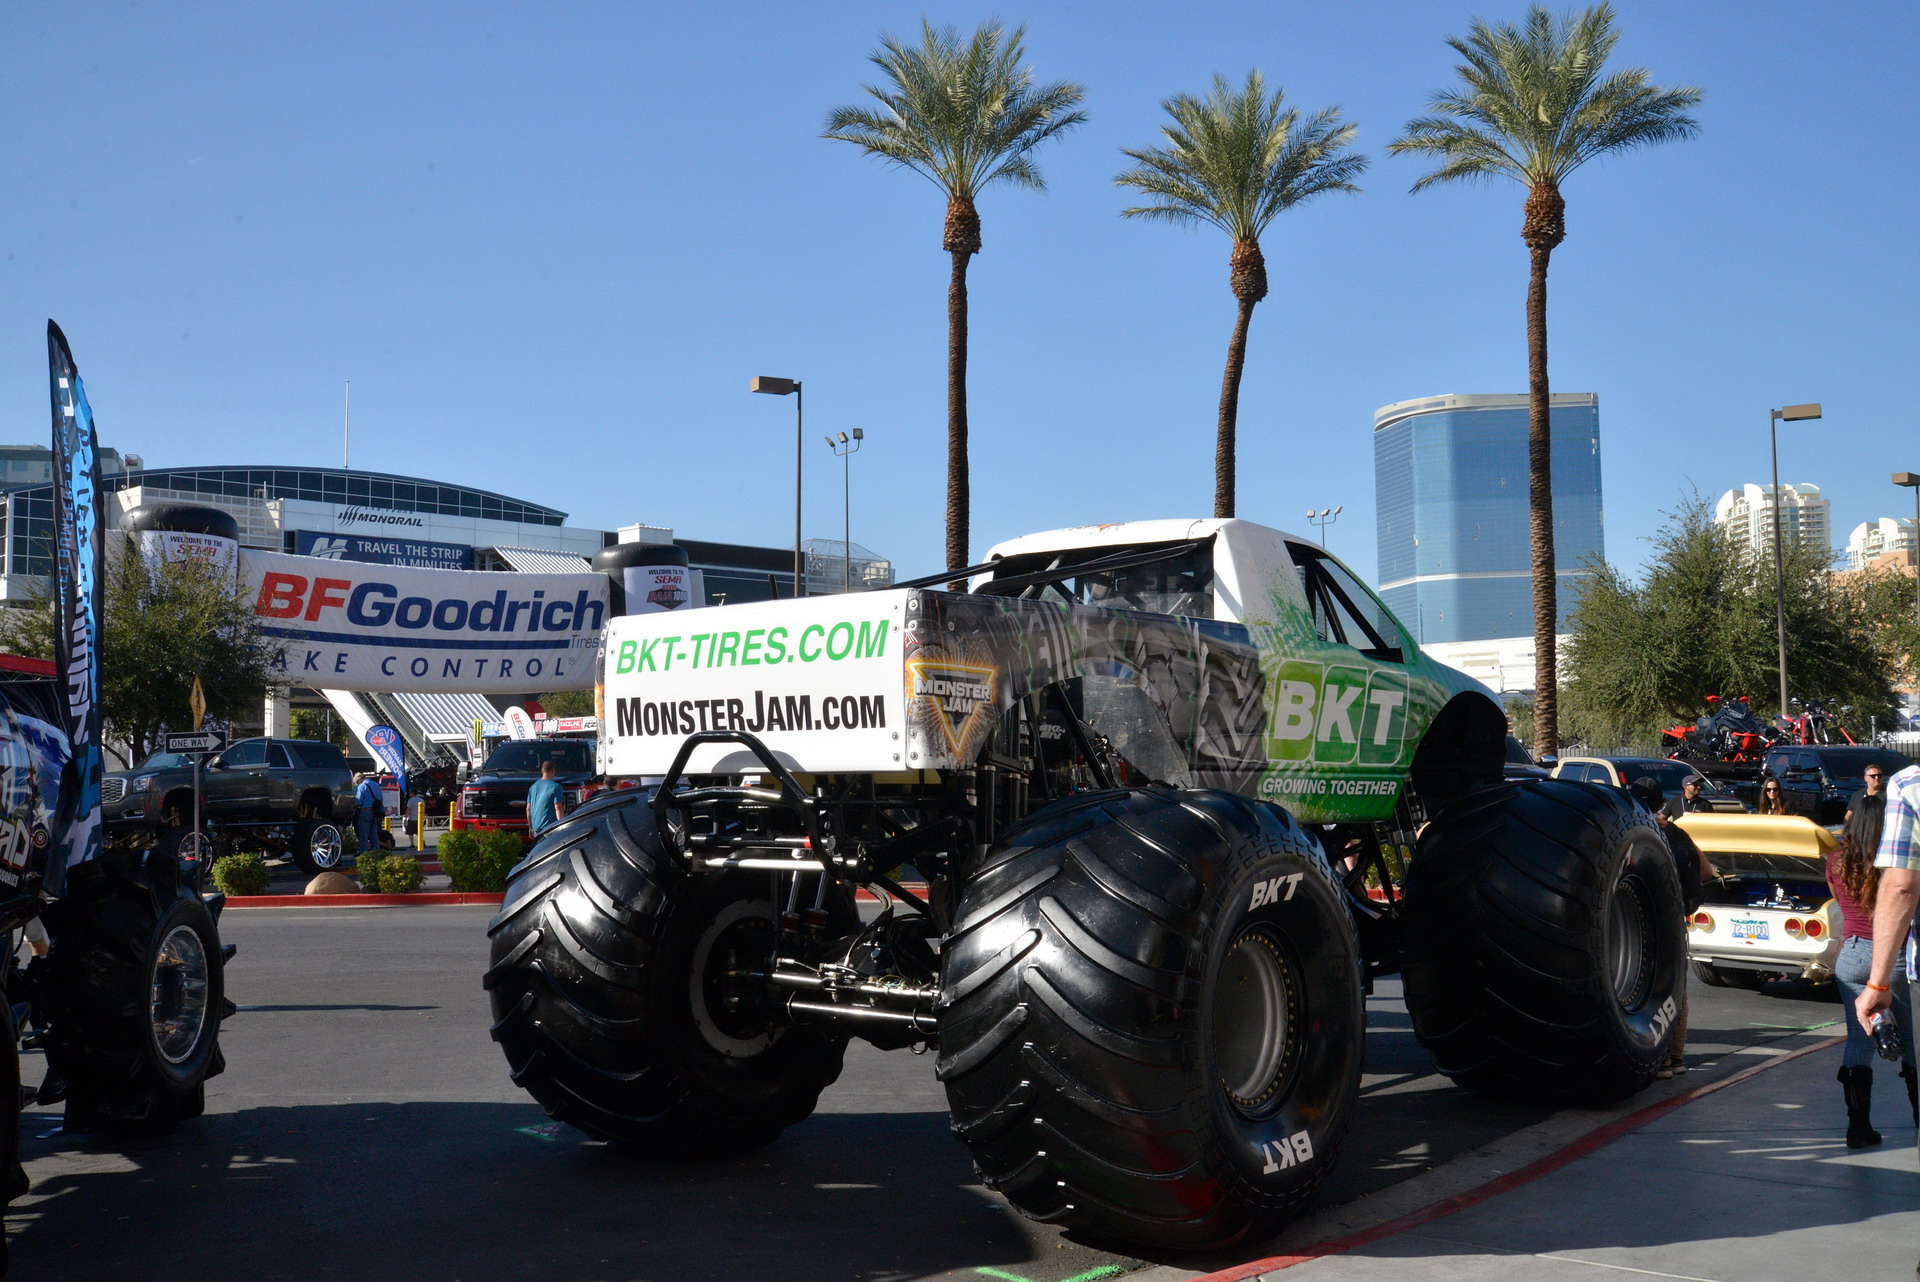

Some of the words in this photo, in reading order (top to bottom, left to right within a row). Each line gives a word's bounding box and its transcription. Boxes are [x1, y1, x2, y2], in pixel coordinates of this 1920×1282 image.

[357, 513, 423, 527] MONORAIL
[170, 536, 202, 545] WELCOME
[204, 538, 212, 546] TO
[357, 541, 402, 555] TRAVEL
[405, 545, 427, 557] THE
[428, 547, 463, 560] STRIP
[393, 557, 406, 567] IN
[409, 558, 463, 571] MINUTES
[253, 571, 604, 632] BFGoodrich
[571, 634, 600, 649] Tires
[616, 619, 890, 675] BKT-TIRES.COM
[254, 645, 348, 673] AKE
[381, 656, 564, 677] CONTROL
[915, 679, 992, 700] MONSTER
[943, 697, 973, 713] JAM
[1274, 679, 1404, 746] BKT
[171, 739, 188, 748] ONE
[191, 738, 208, 747] WAY
[1262, 777, 1326, 795] GROWING
[1330, 779, 1397, 796] TOGETHER
[1248, 872, 1304, 912] BKT
[1649, 994, 1678, 1047] BKT
[1262, 1129, 1314, 1175] BKT
